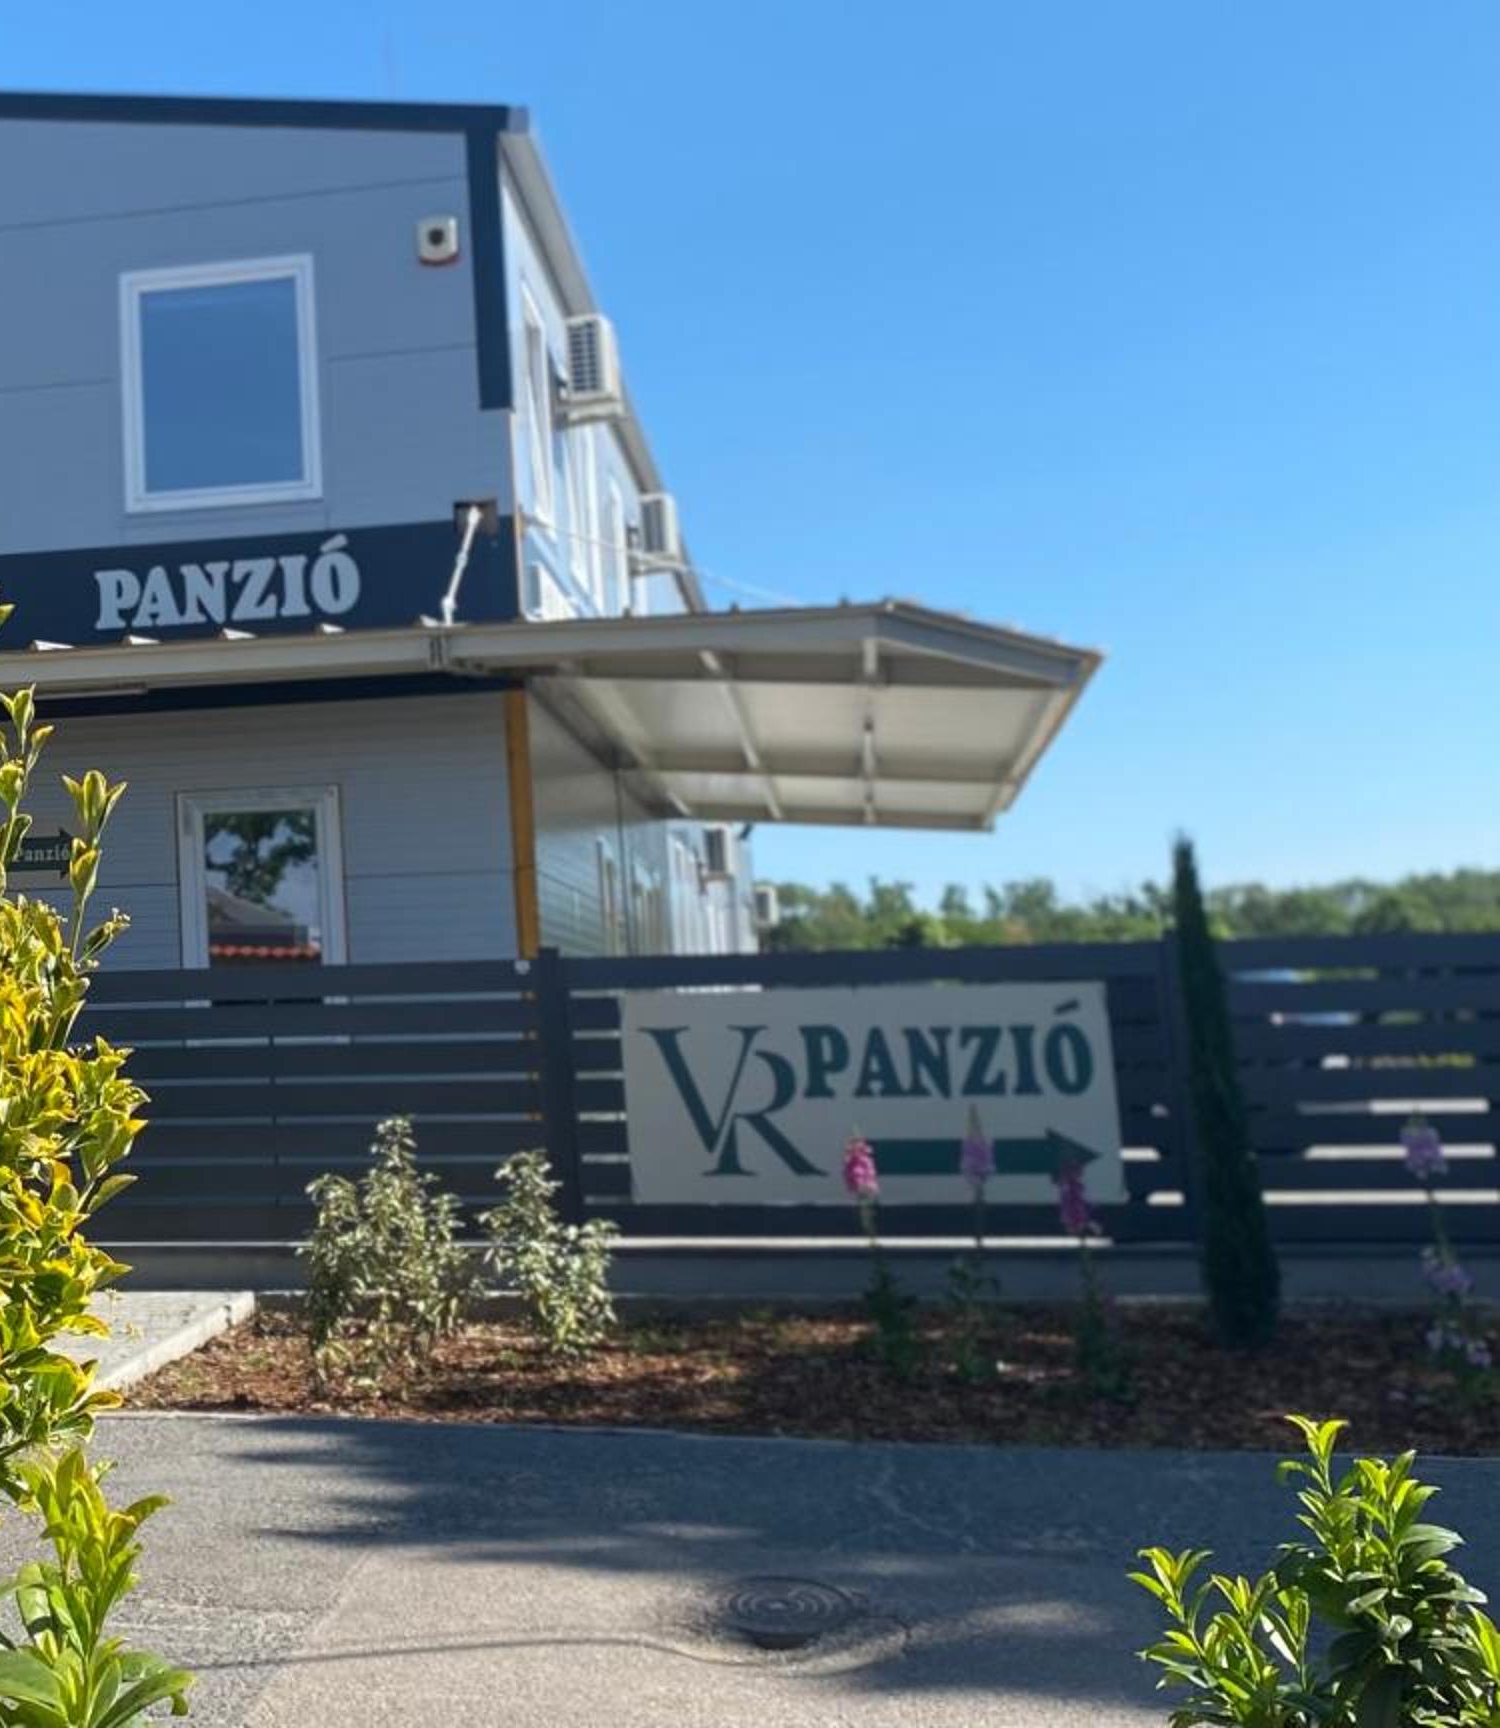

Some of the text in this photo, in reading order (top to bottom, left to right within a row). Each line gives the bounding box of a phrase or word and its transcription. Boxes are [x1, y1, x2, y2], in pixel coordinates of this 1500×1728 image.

[94, 533, 360, 630] PANZIÓ
[638, 999, 1095, 1177] VR PANZIÓ
